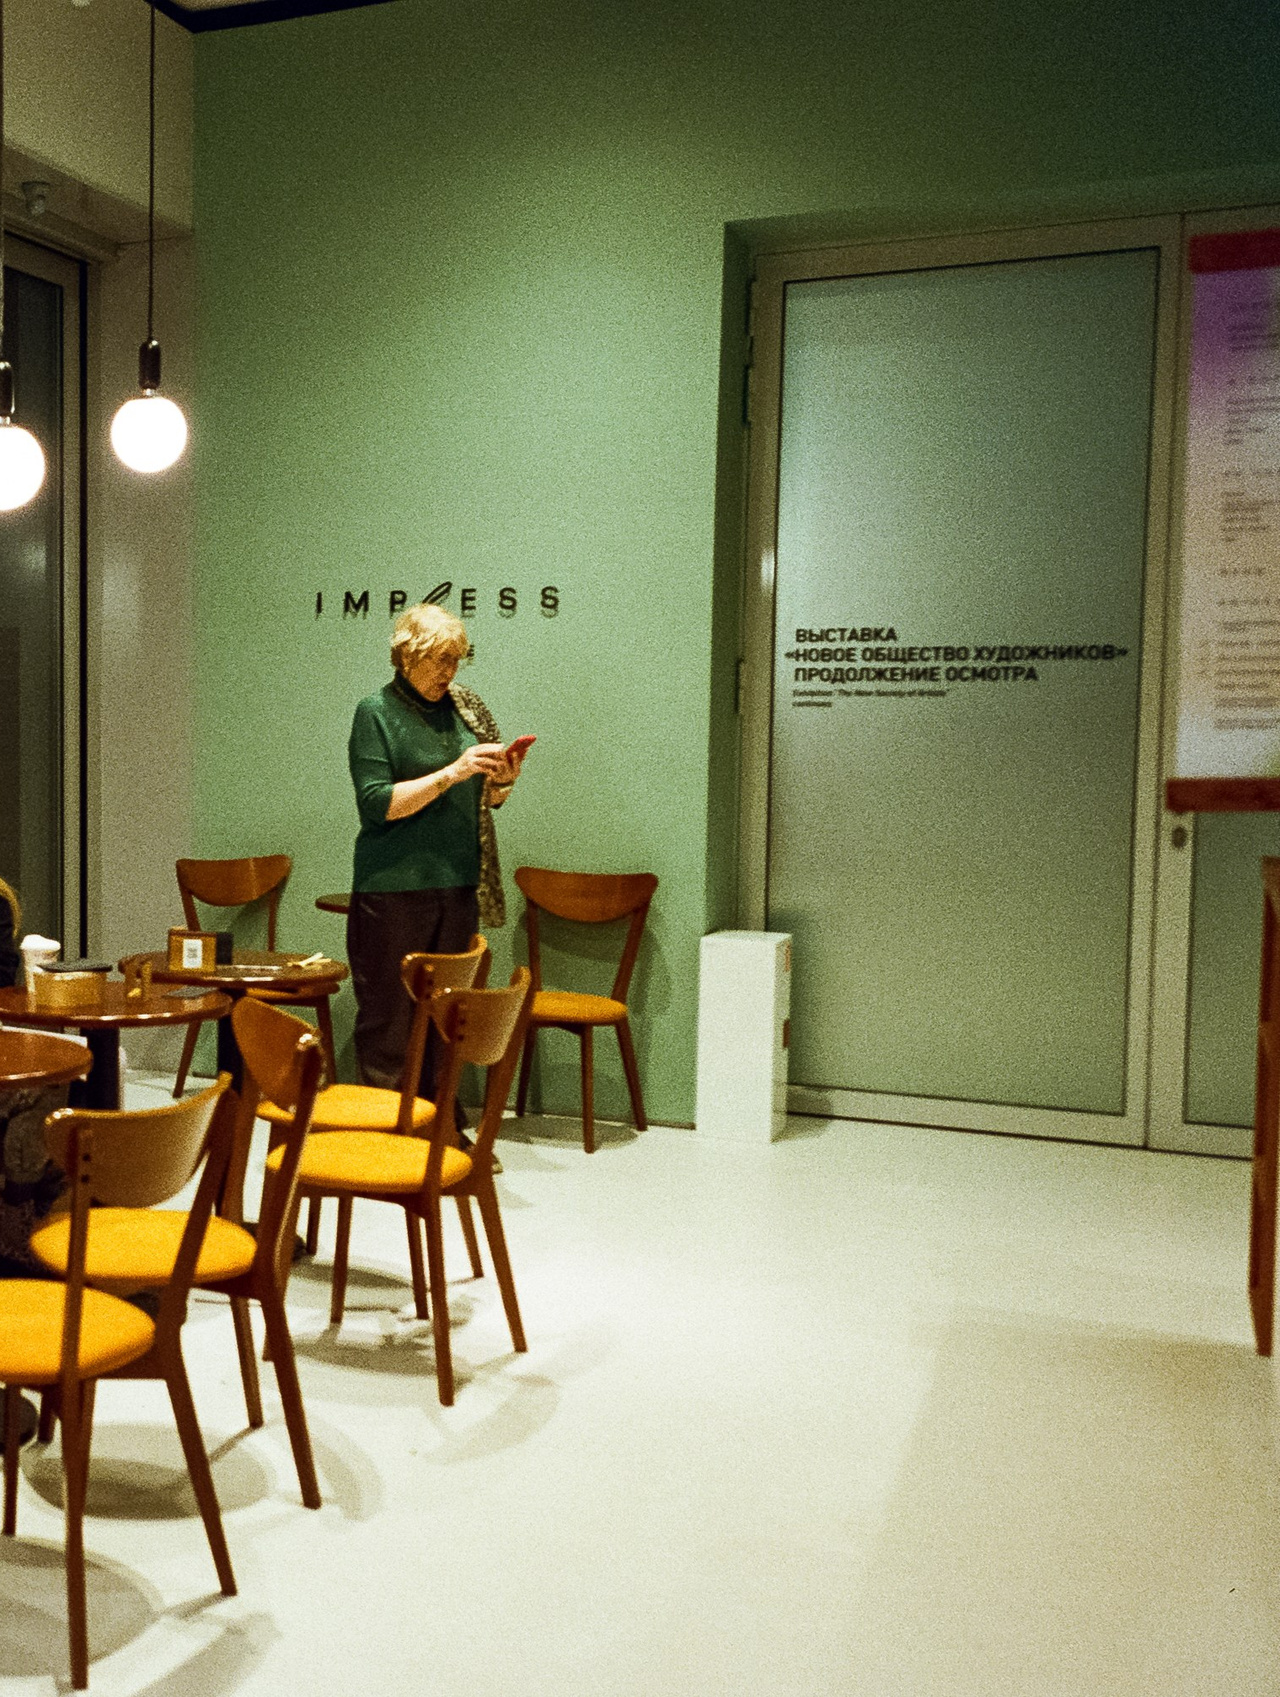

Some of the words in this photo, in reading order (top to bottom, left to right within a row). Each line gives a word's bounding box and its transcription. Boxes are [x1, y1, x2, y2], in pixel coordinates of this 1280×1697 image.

[796, 628, 898, 645] ВЫСТАВКА
[784, 647, 857, 663] «НОВОЕ
[861, 646, 969, 664] ОБЩЕСТВО
[974, 644, 1129, 663] ХУДОЖНИКОВ»
[794, 666, 941, 685] ПРОДОЛЖЕНИЕ
[945, 666, 1039, 683] ОСМОТРА
